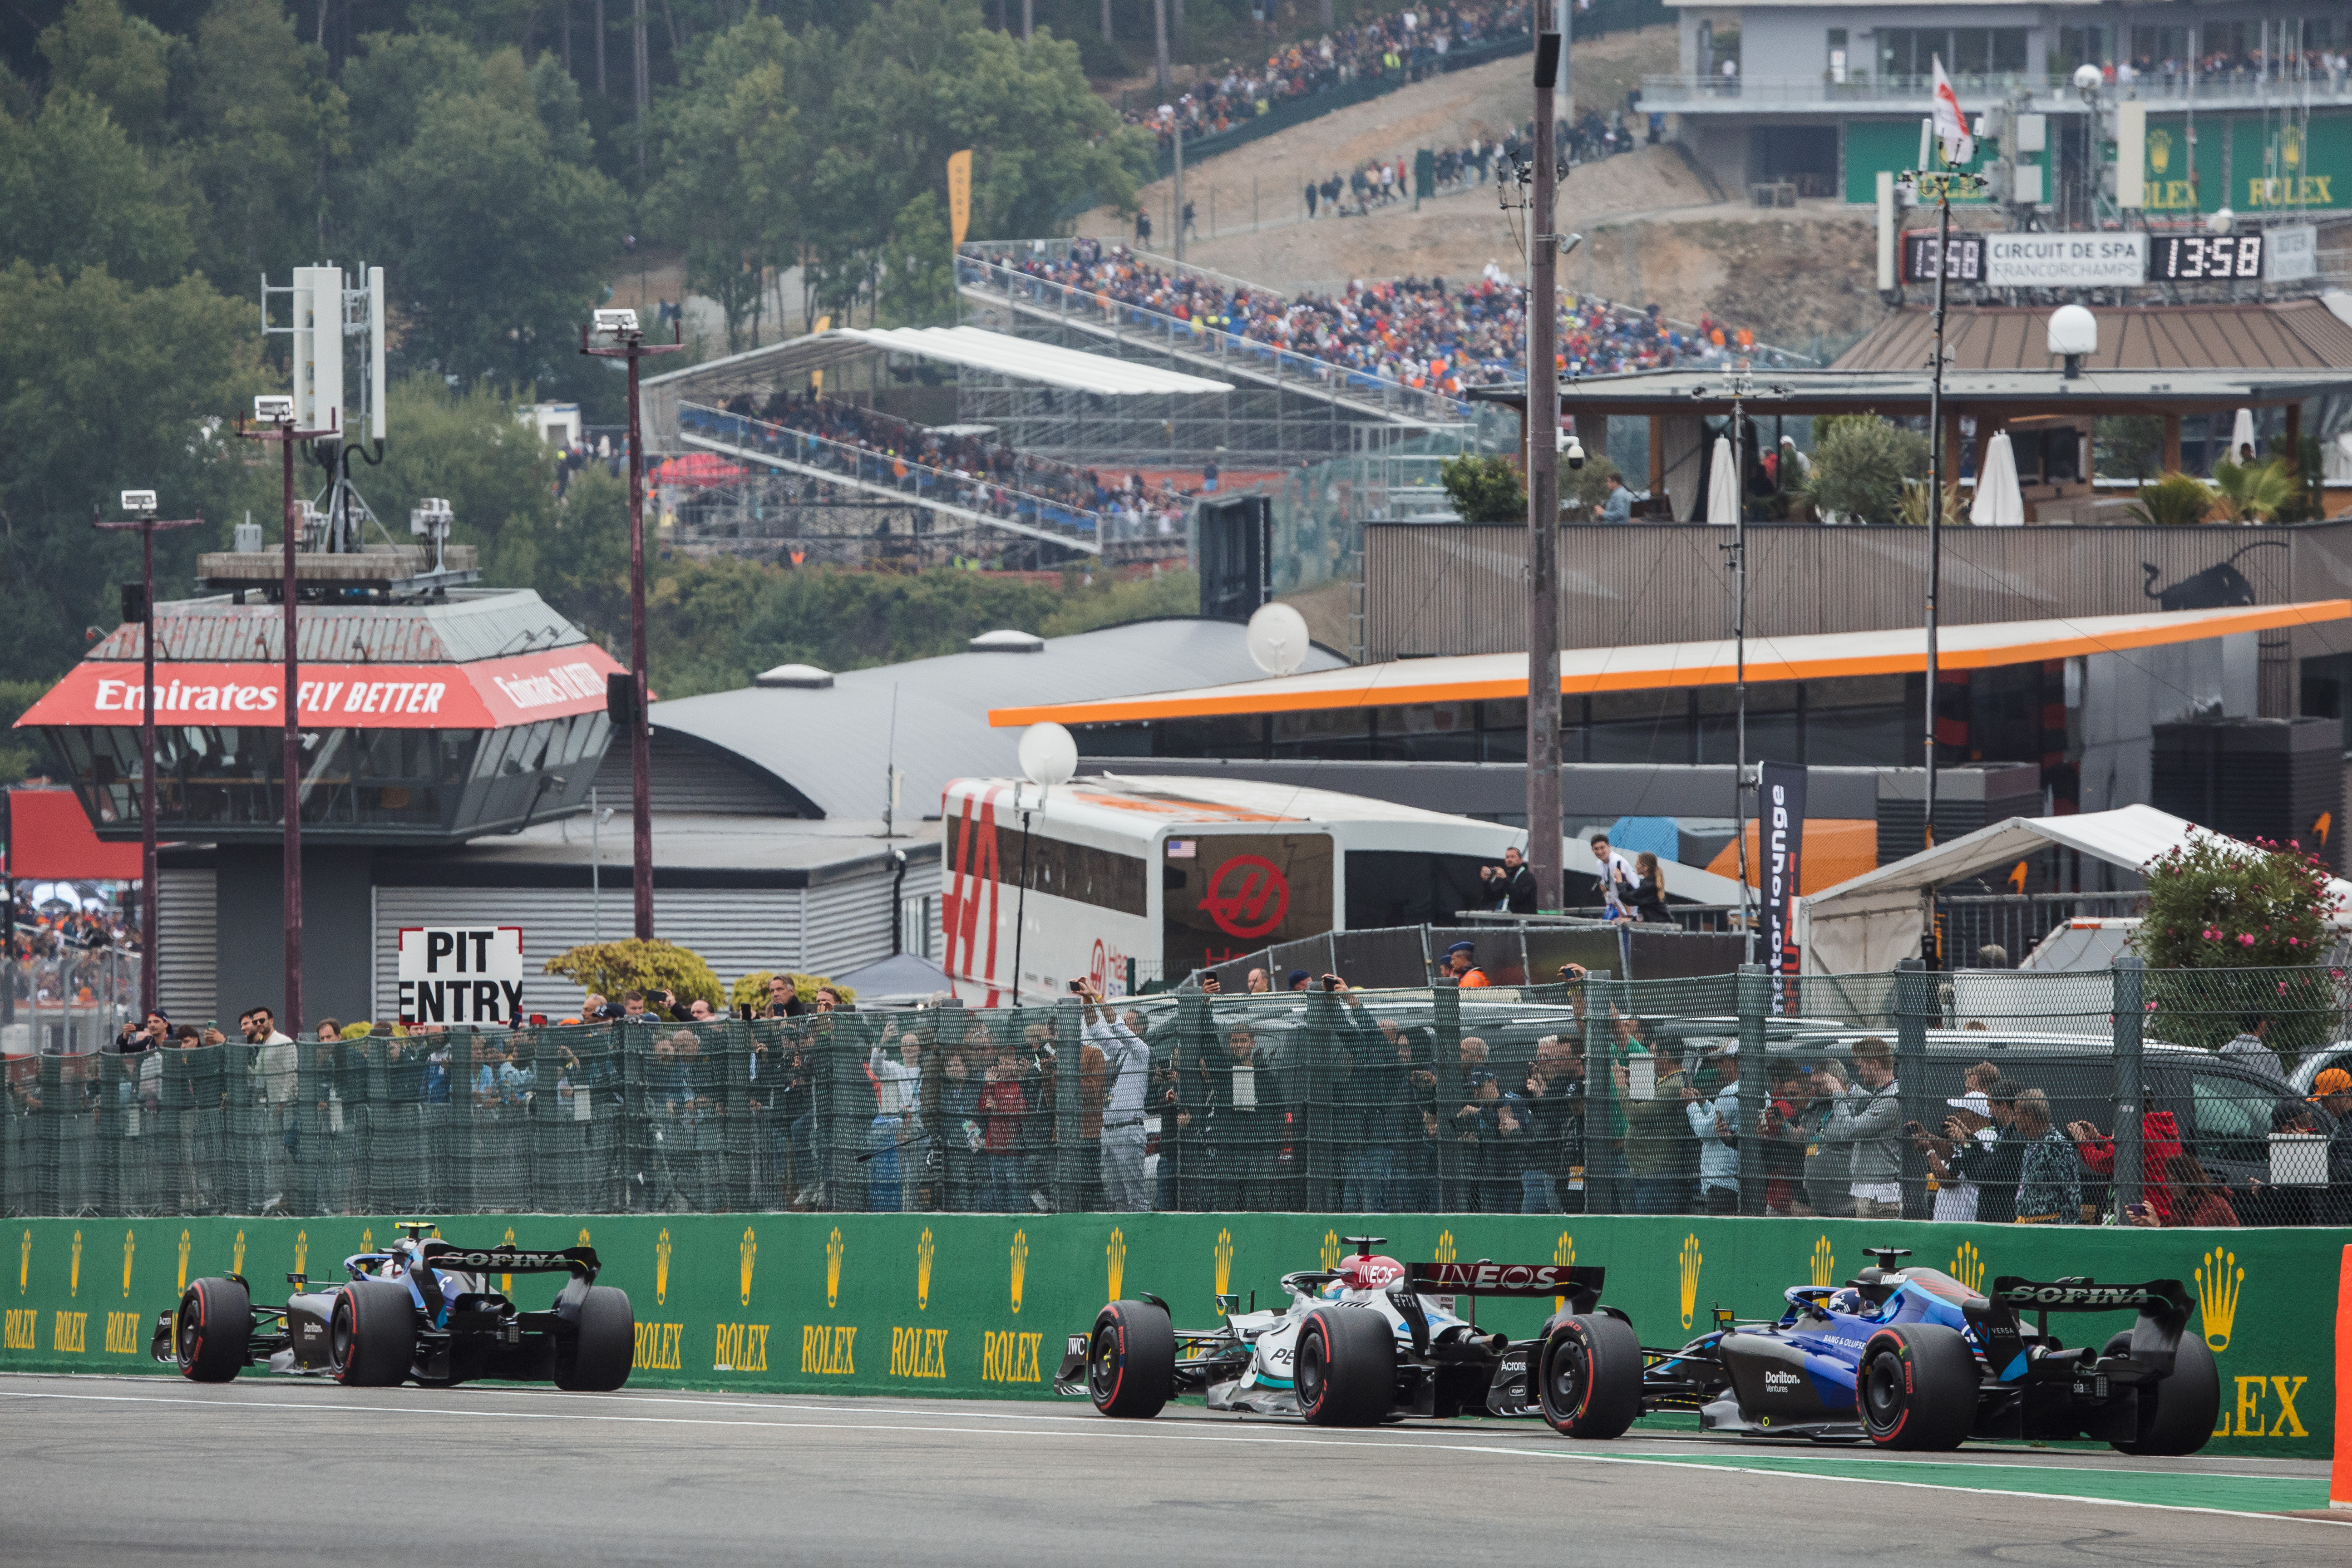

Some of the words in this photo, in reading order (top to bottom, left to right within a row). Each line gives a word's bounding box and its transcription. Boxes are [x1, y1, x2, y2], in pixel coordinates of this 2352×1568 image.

[1993, 242, 2064, 259] CIRCUIT
[2070, 242, 2096, 259] DE
[2101, 242, 2137, 259] SPA
[2167, 237, 2261, 278] 13:58
[1993, 262, 2138, 278] FRANCORCHAMPS
[94, 679, 279, 711] Emirates
[297, 681, 344, 712] FLY
[343, 681, 445, 713] BETTER
[1770, 784, 1788, 907] lounge
[427, 931, 494, 973] PIT
[399, 980, 522, 1022] ENTRY
[440, 1252, 568, 1267] SOFINA
[1359, 1265, 1397, 1284] INEOS
[1435, 1265, 1559, 1289] INEOS
[1400, 1294, 1418, 1307] FTX
[2006, 1286, 2148, 1304] SOFINA
[4, 1309, 38, 1349] ROLEX
[54, 1311, 88, 1352] ROLEX
[105, 1311, 140, 1353] ROLEX
[632, 1322, 683, 1370] ROLEX
[1823, 1335, 1839, 1344] BANG
[1844, 1339, 1866, 1350] OLUFSE
[715, 1322, 769, 1371] ROLEX
[801, 1325, 857, 1374] ROLEX
[889, 1326, 948, 1378] ROLEX
[982, 1331, 1043, 1382] ROLEX
[1068, 1338, 1085, 1355] IWC
[1247, 1346, 1259, 1375] 3
[1501, 1361, 1526, 1371] Acronis
[1765, 1384, 1788, 1393] Ventures
